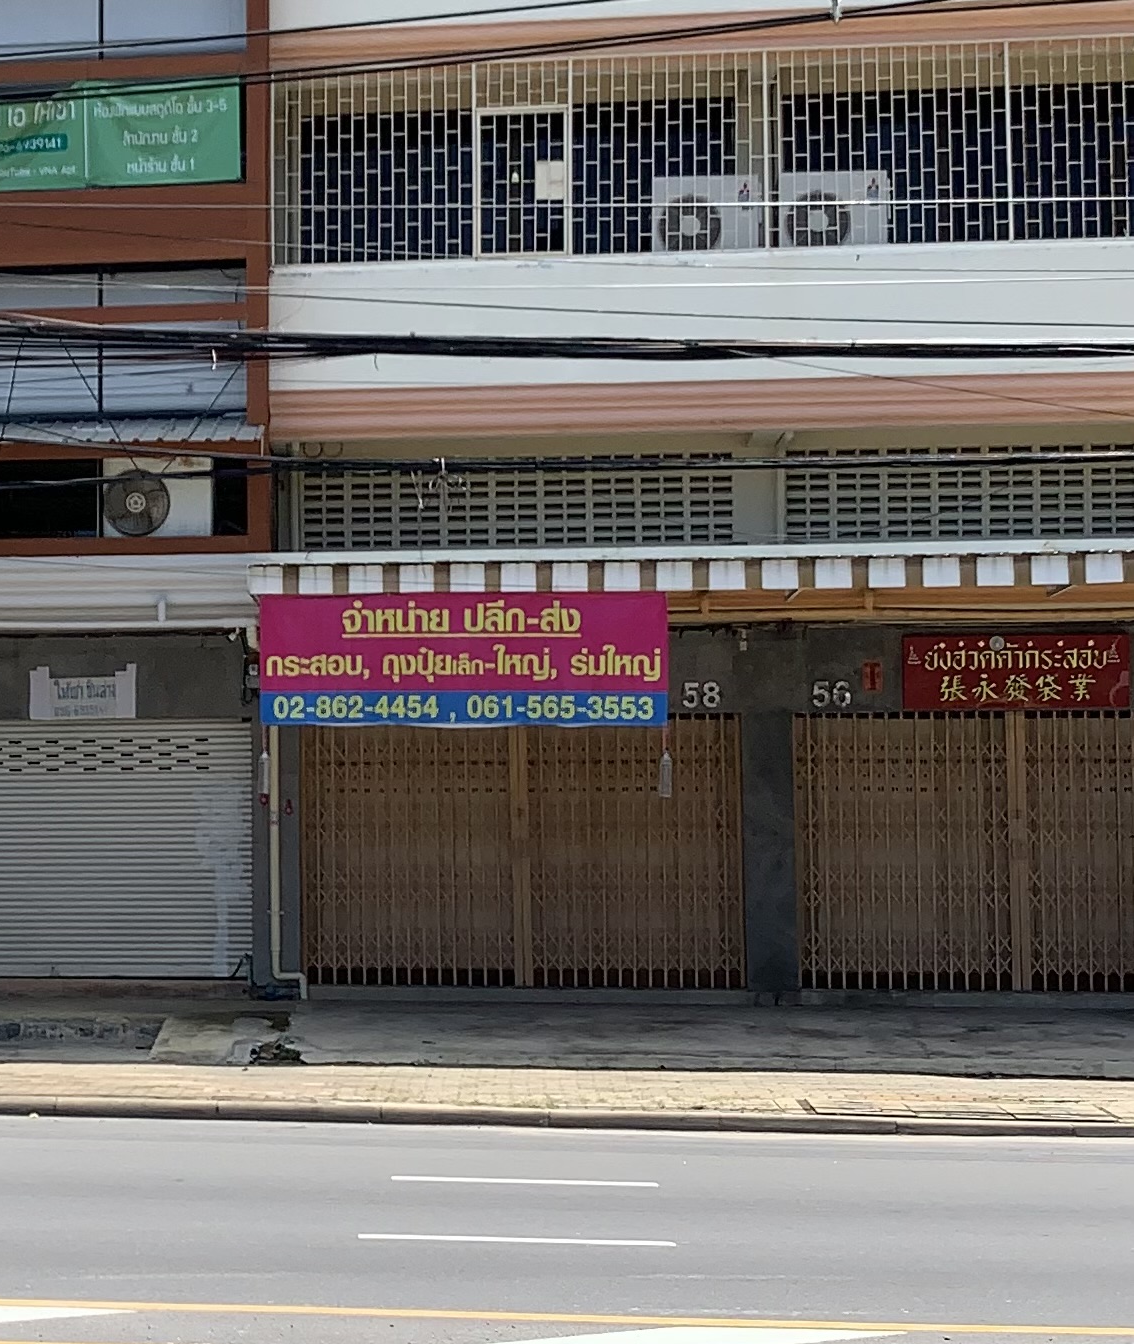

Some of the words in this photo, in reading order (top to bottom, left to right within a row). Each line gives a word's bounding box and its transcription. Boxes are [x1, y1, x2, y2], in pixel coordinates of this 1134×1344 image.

[191, 129, 198, 143] 2
[190, 157, 195, 170] 1
[342, 600, 449, 633] จำหน่าย
[464, 599, 582, 633] ปลีก-ส่ง
[570, 644, 662, 683] ร่มใหญ่
[682, 681, 721, 709] 58
[812, 681, 852, 707] 56
[940, 674, 1097, 702] 張永發袋業
[273, 695, 439, 720] 02-862-4454
[467, 694, 655, 720] 061-565-3553
